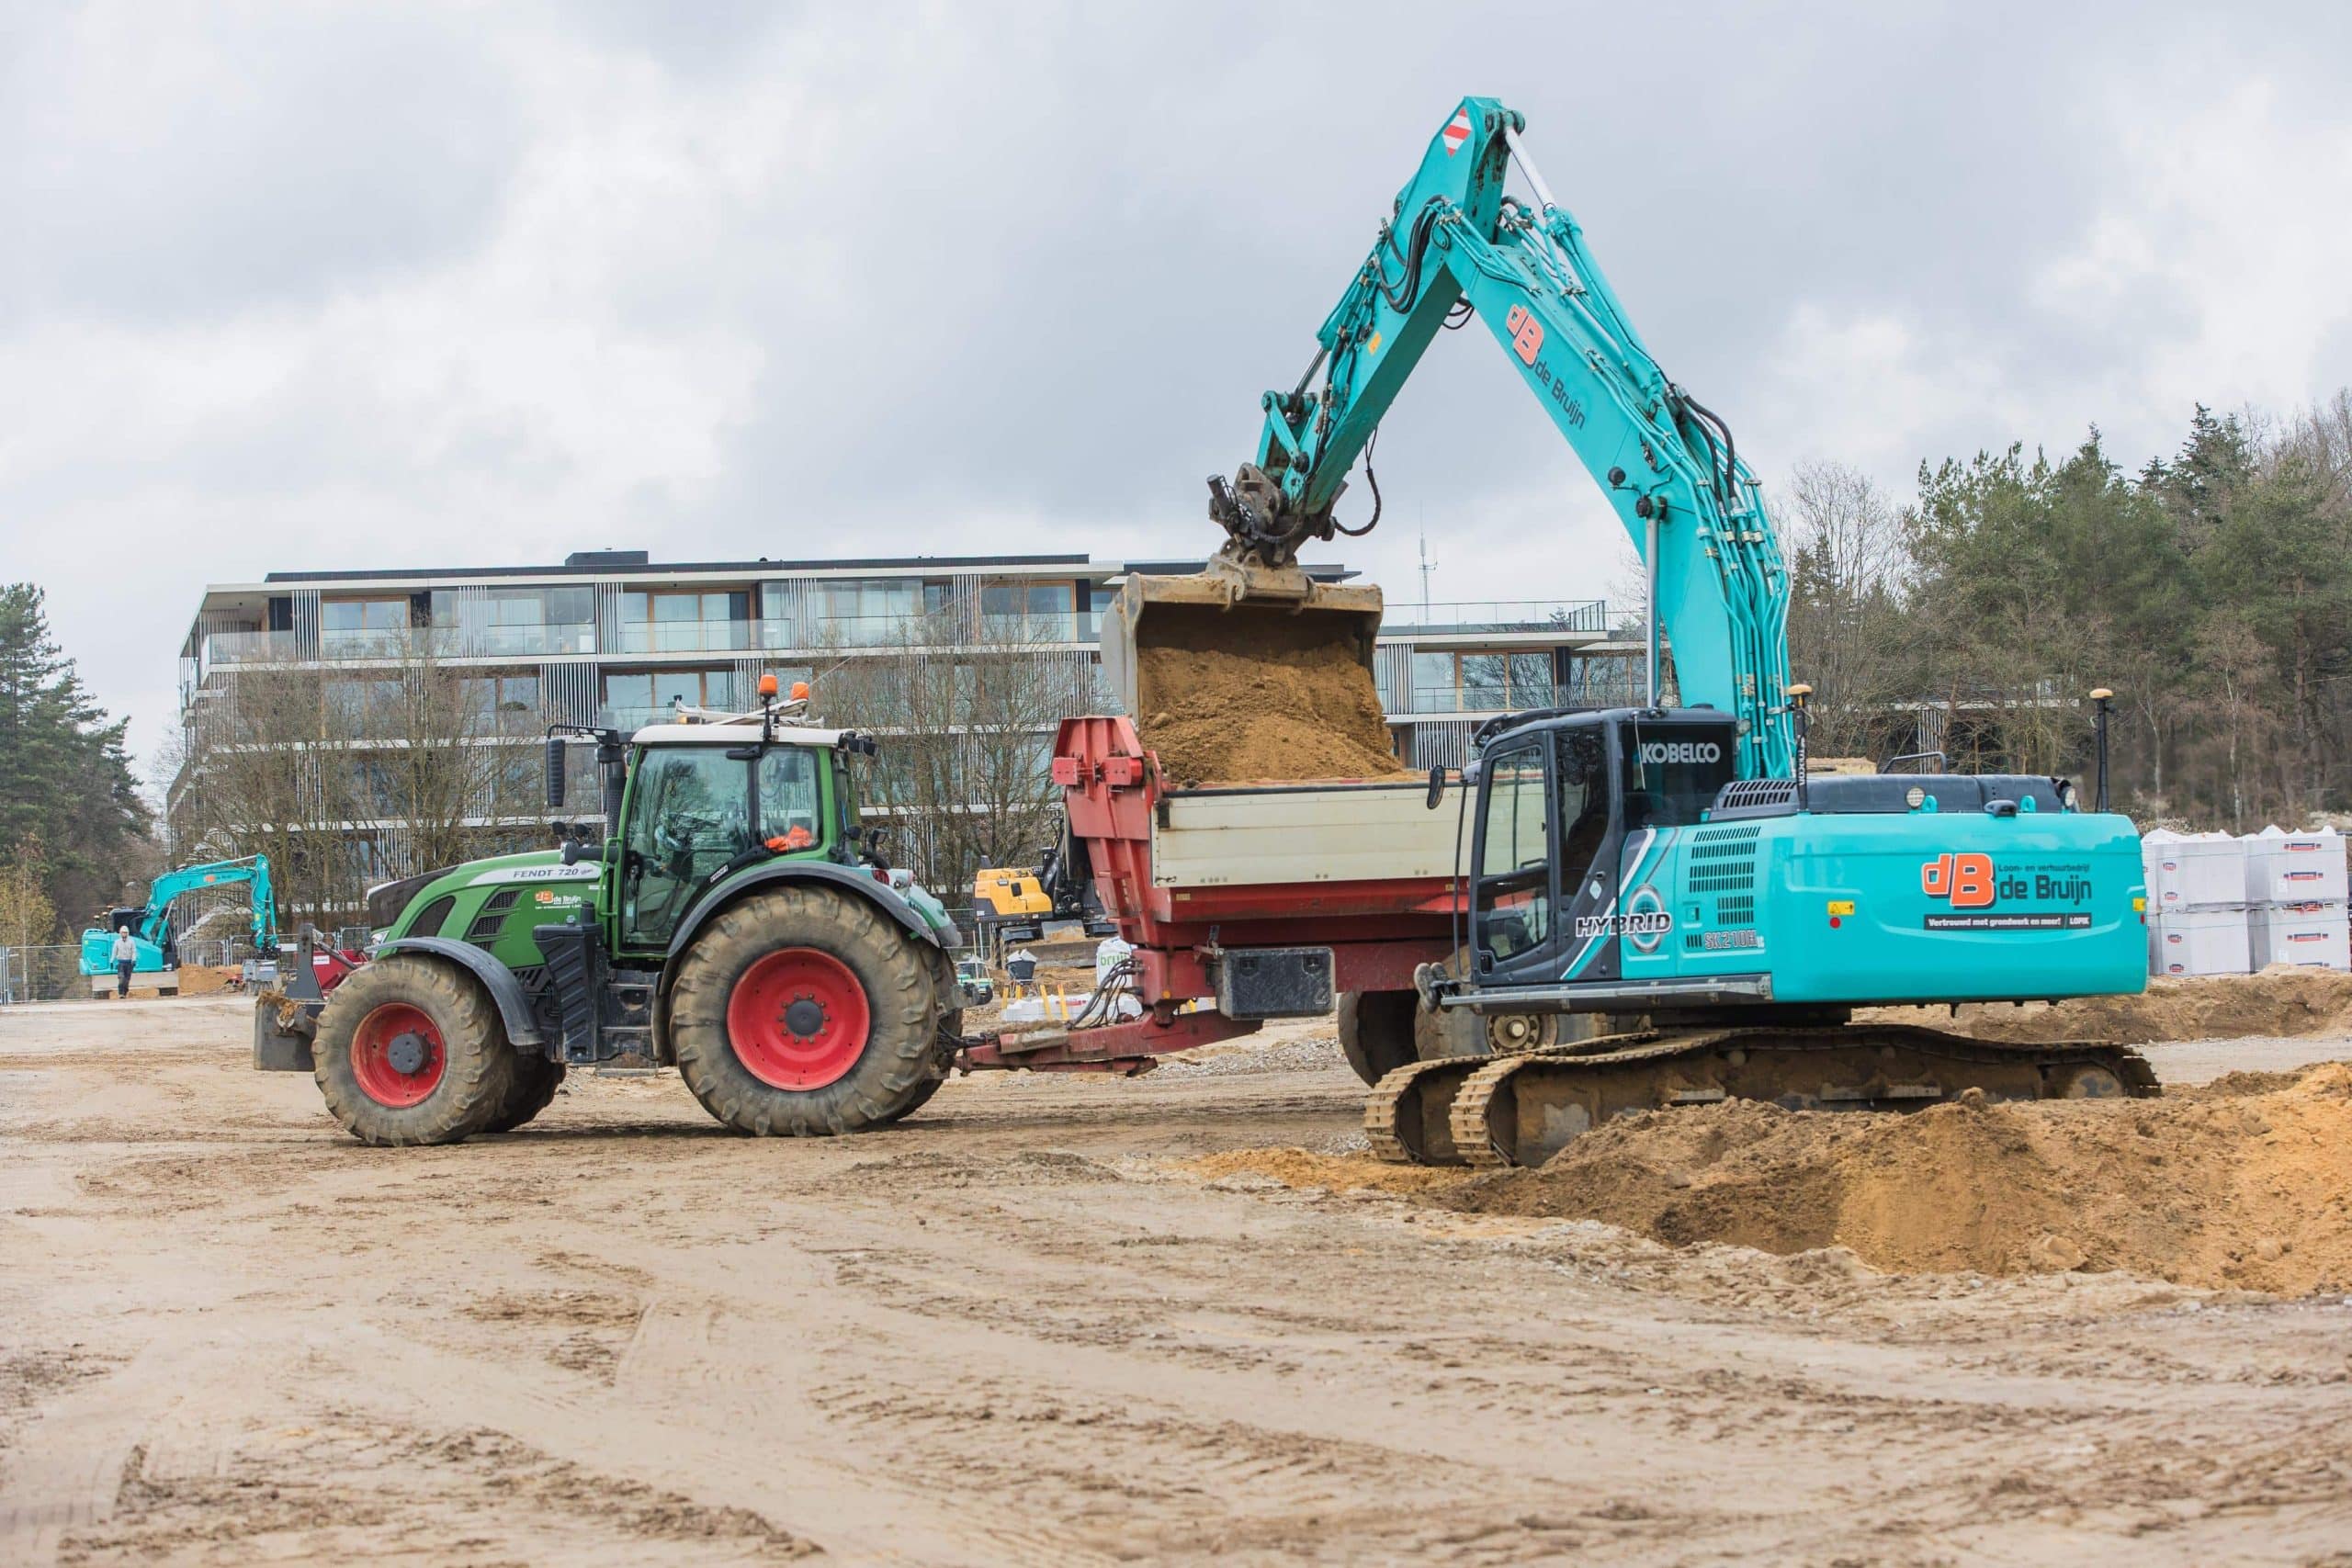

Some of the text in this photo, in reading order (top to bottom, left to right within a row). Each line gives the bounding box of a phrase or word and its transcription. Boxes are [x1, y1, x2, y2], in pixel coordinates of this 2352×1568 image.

[1506, 303, 1586, 429] dB de Bruijn
[1642, 742, 1721, 764] KOBELCO
[513, 869, 553, 878] FENDT
[558, 868, 579, 876] 720
[1922, 853, 1996, 909] dB
[1999, 874, 2092, 906] de Bruijn
[1576, 912, 1672, 938] HYBRID
